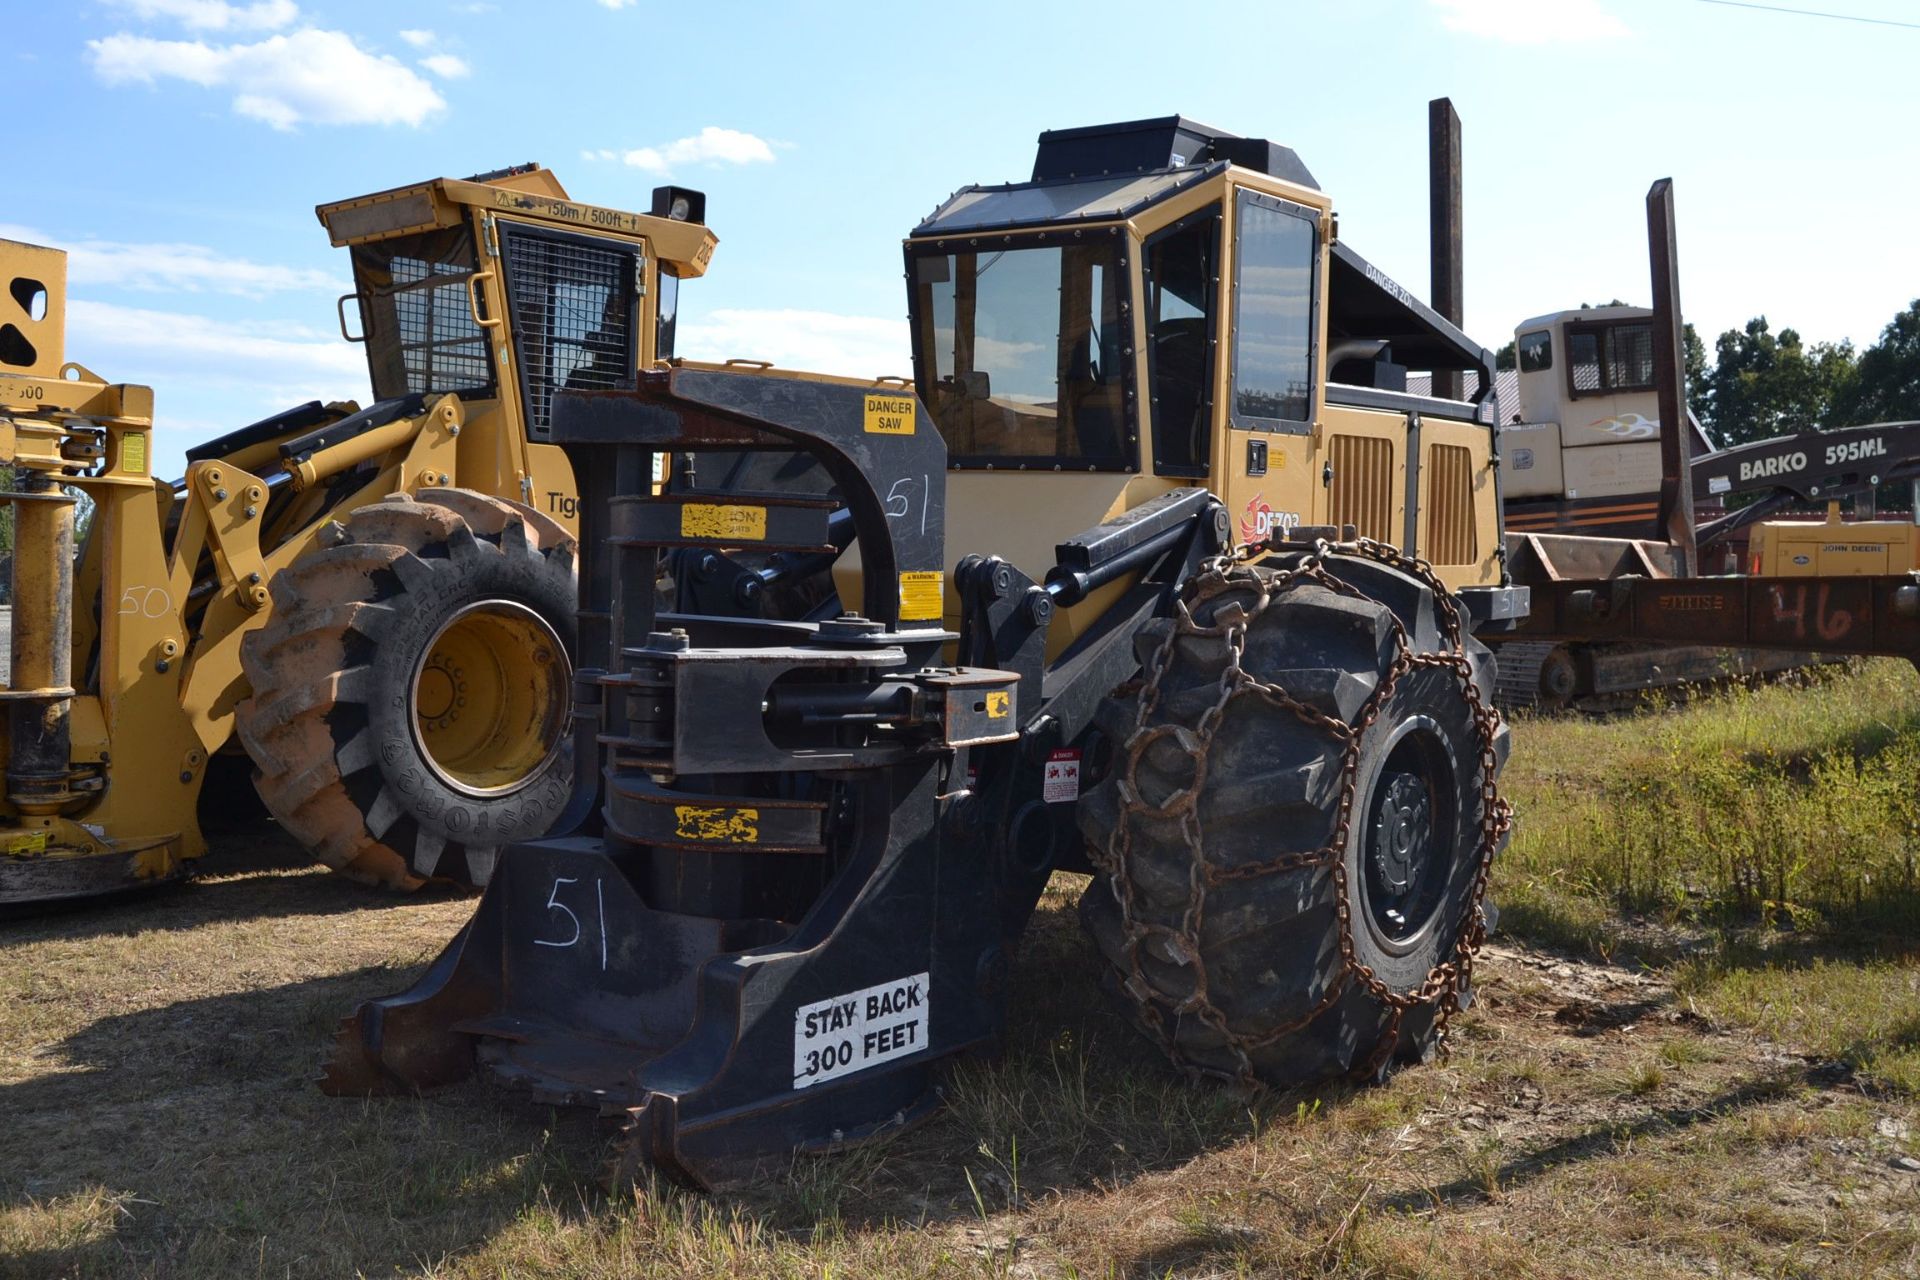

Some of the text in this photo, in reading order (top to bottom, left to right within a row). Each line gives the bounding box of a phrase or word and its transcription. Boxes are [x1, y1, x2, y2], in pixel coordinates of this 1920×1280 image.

[591, 210, 622, 228] 500ft
[1365, 264, 1399, 299] DANGER
[868, 400, 912, 414] DANGER
[878, 417, 902, 430] SAW
[1740, 452, 1807, 481] BARKO
[885, 474, 929, 536] 51
[1823, 545, 1884, 553] JOHN DEERE
[117, 585, 170, 618] 50
[1773, 584, 1851, 640] 46
[534, 878, 607, 971] 51
[805, 983, 920, 1039] STAY BACK
[806, 1020, 919, 1076] 300 FEET
